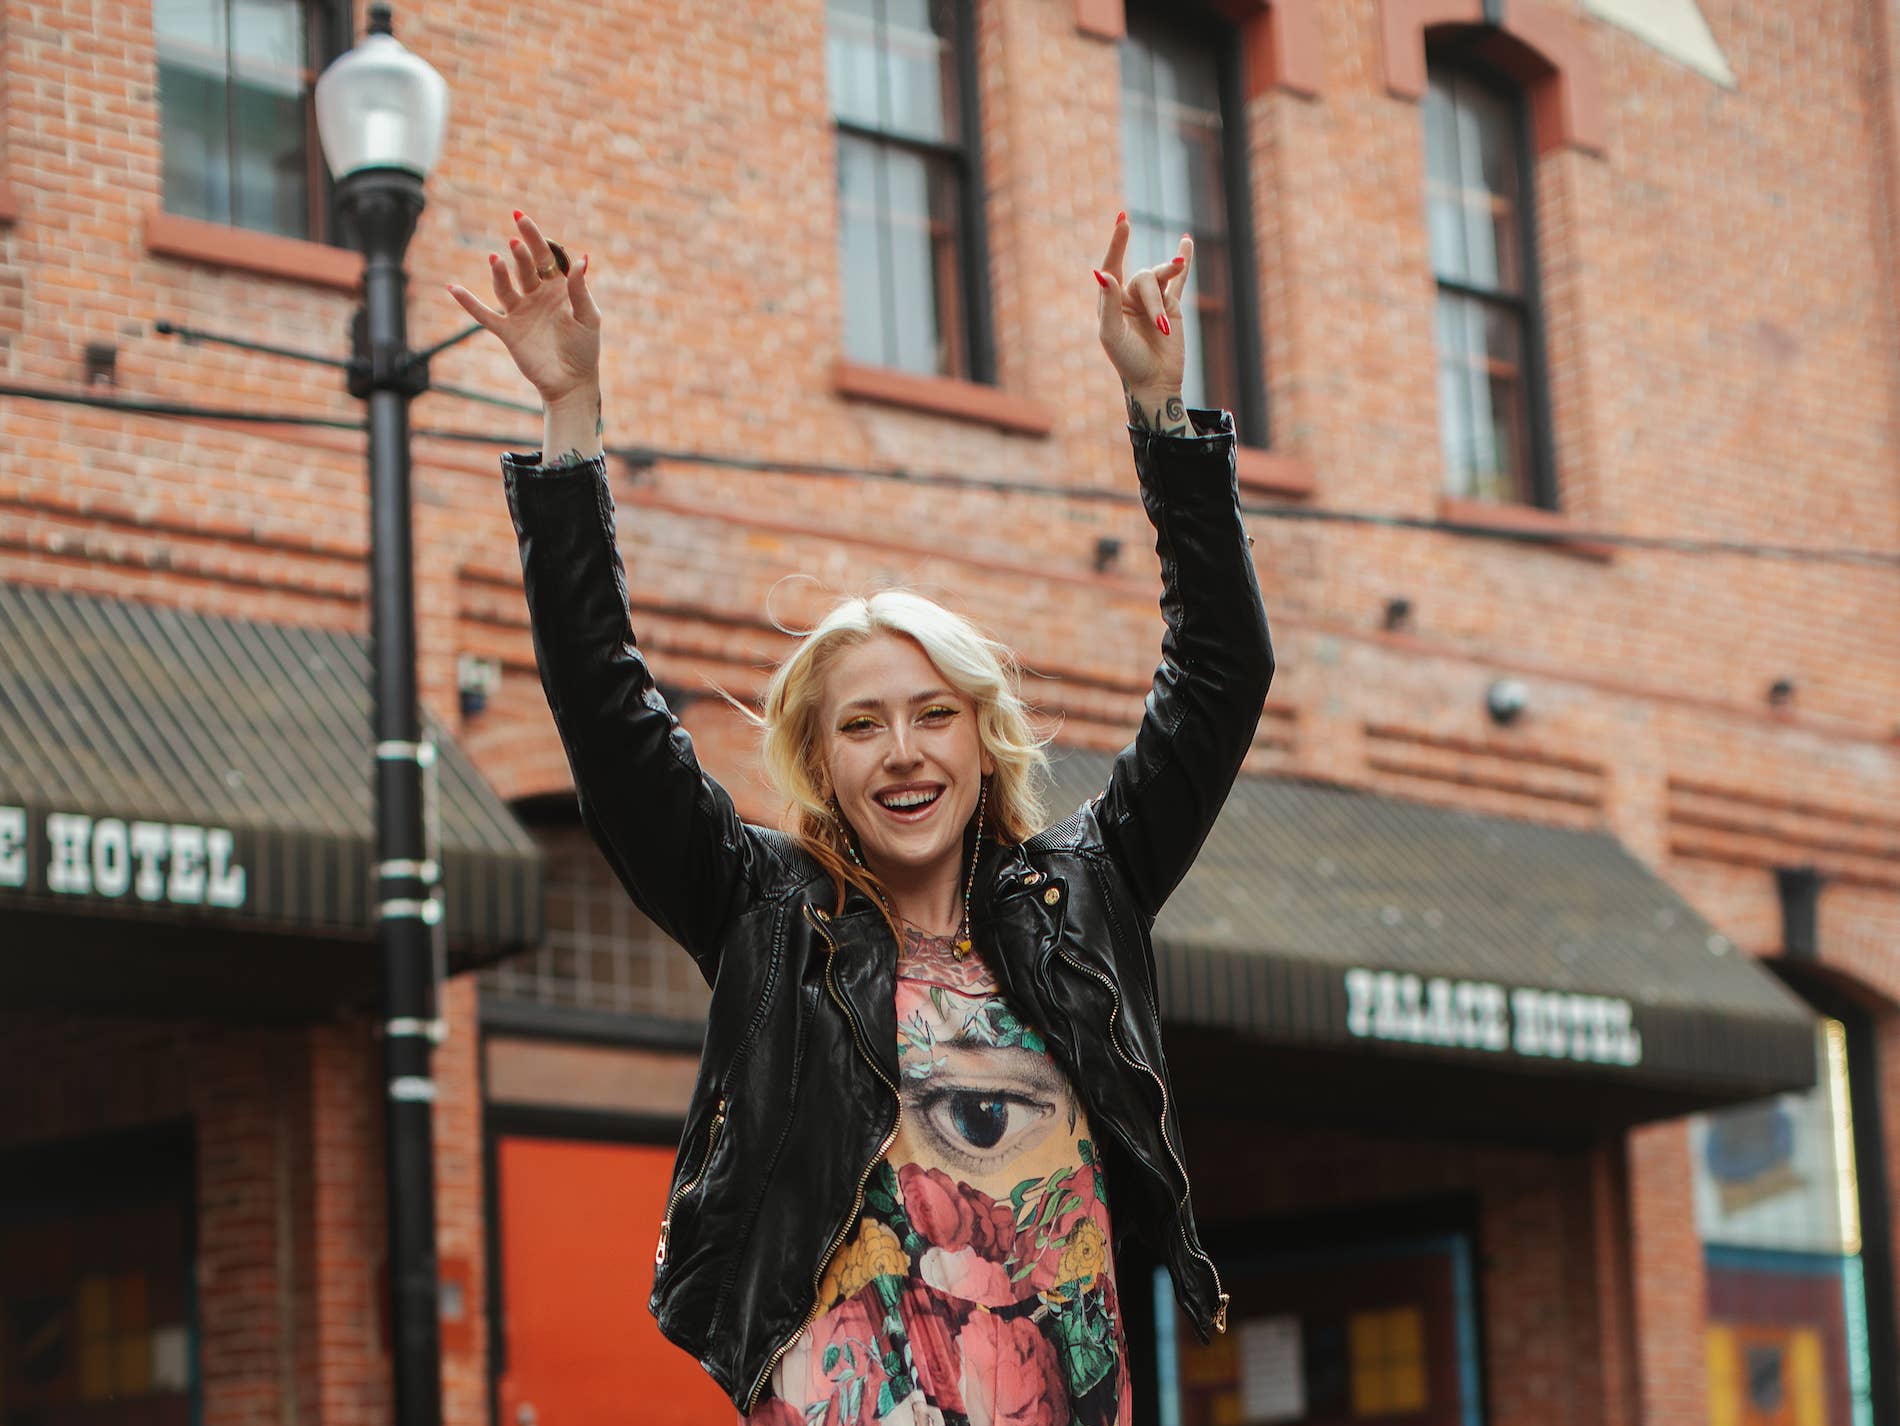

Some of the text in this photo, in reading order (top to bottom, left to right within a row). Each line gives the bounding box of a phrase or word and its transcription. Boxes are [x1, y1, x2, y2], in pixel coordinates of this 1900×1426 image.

[46, 812, 246, 908] HOTEL
[1345, 967, 1642, 1066] PALACE HOTEL
